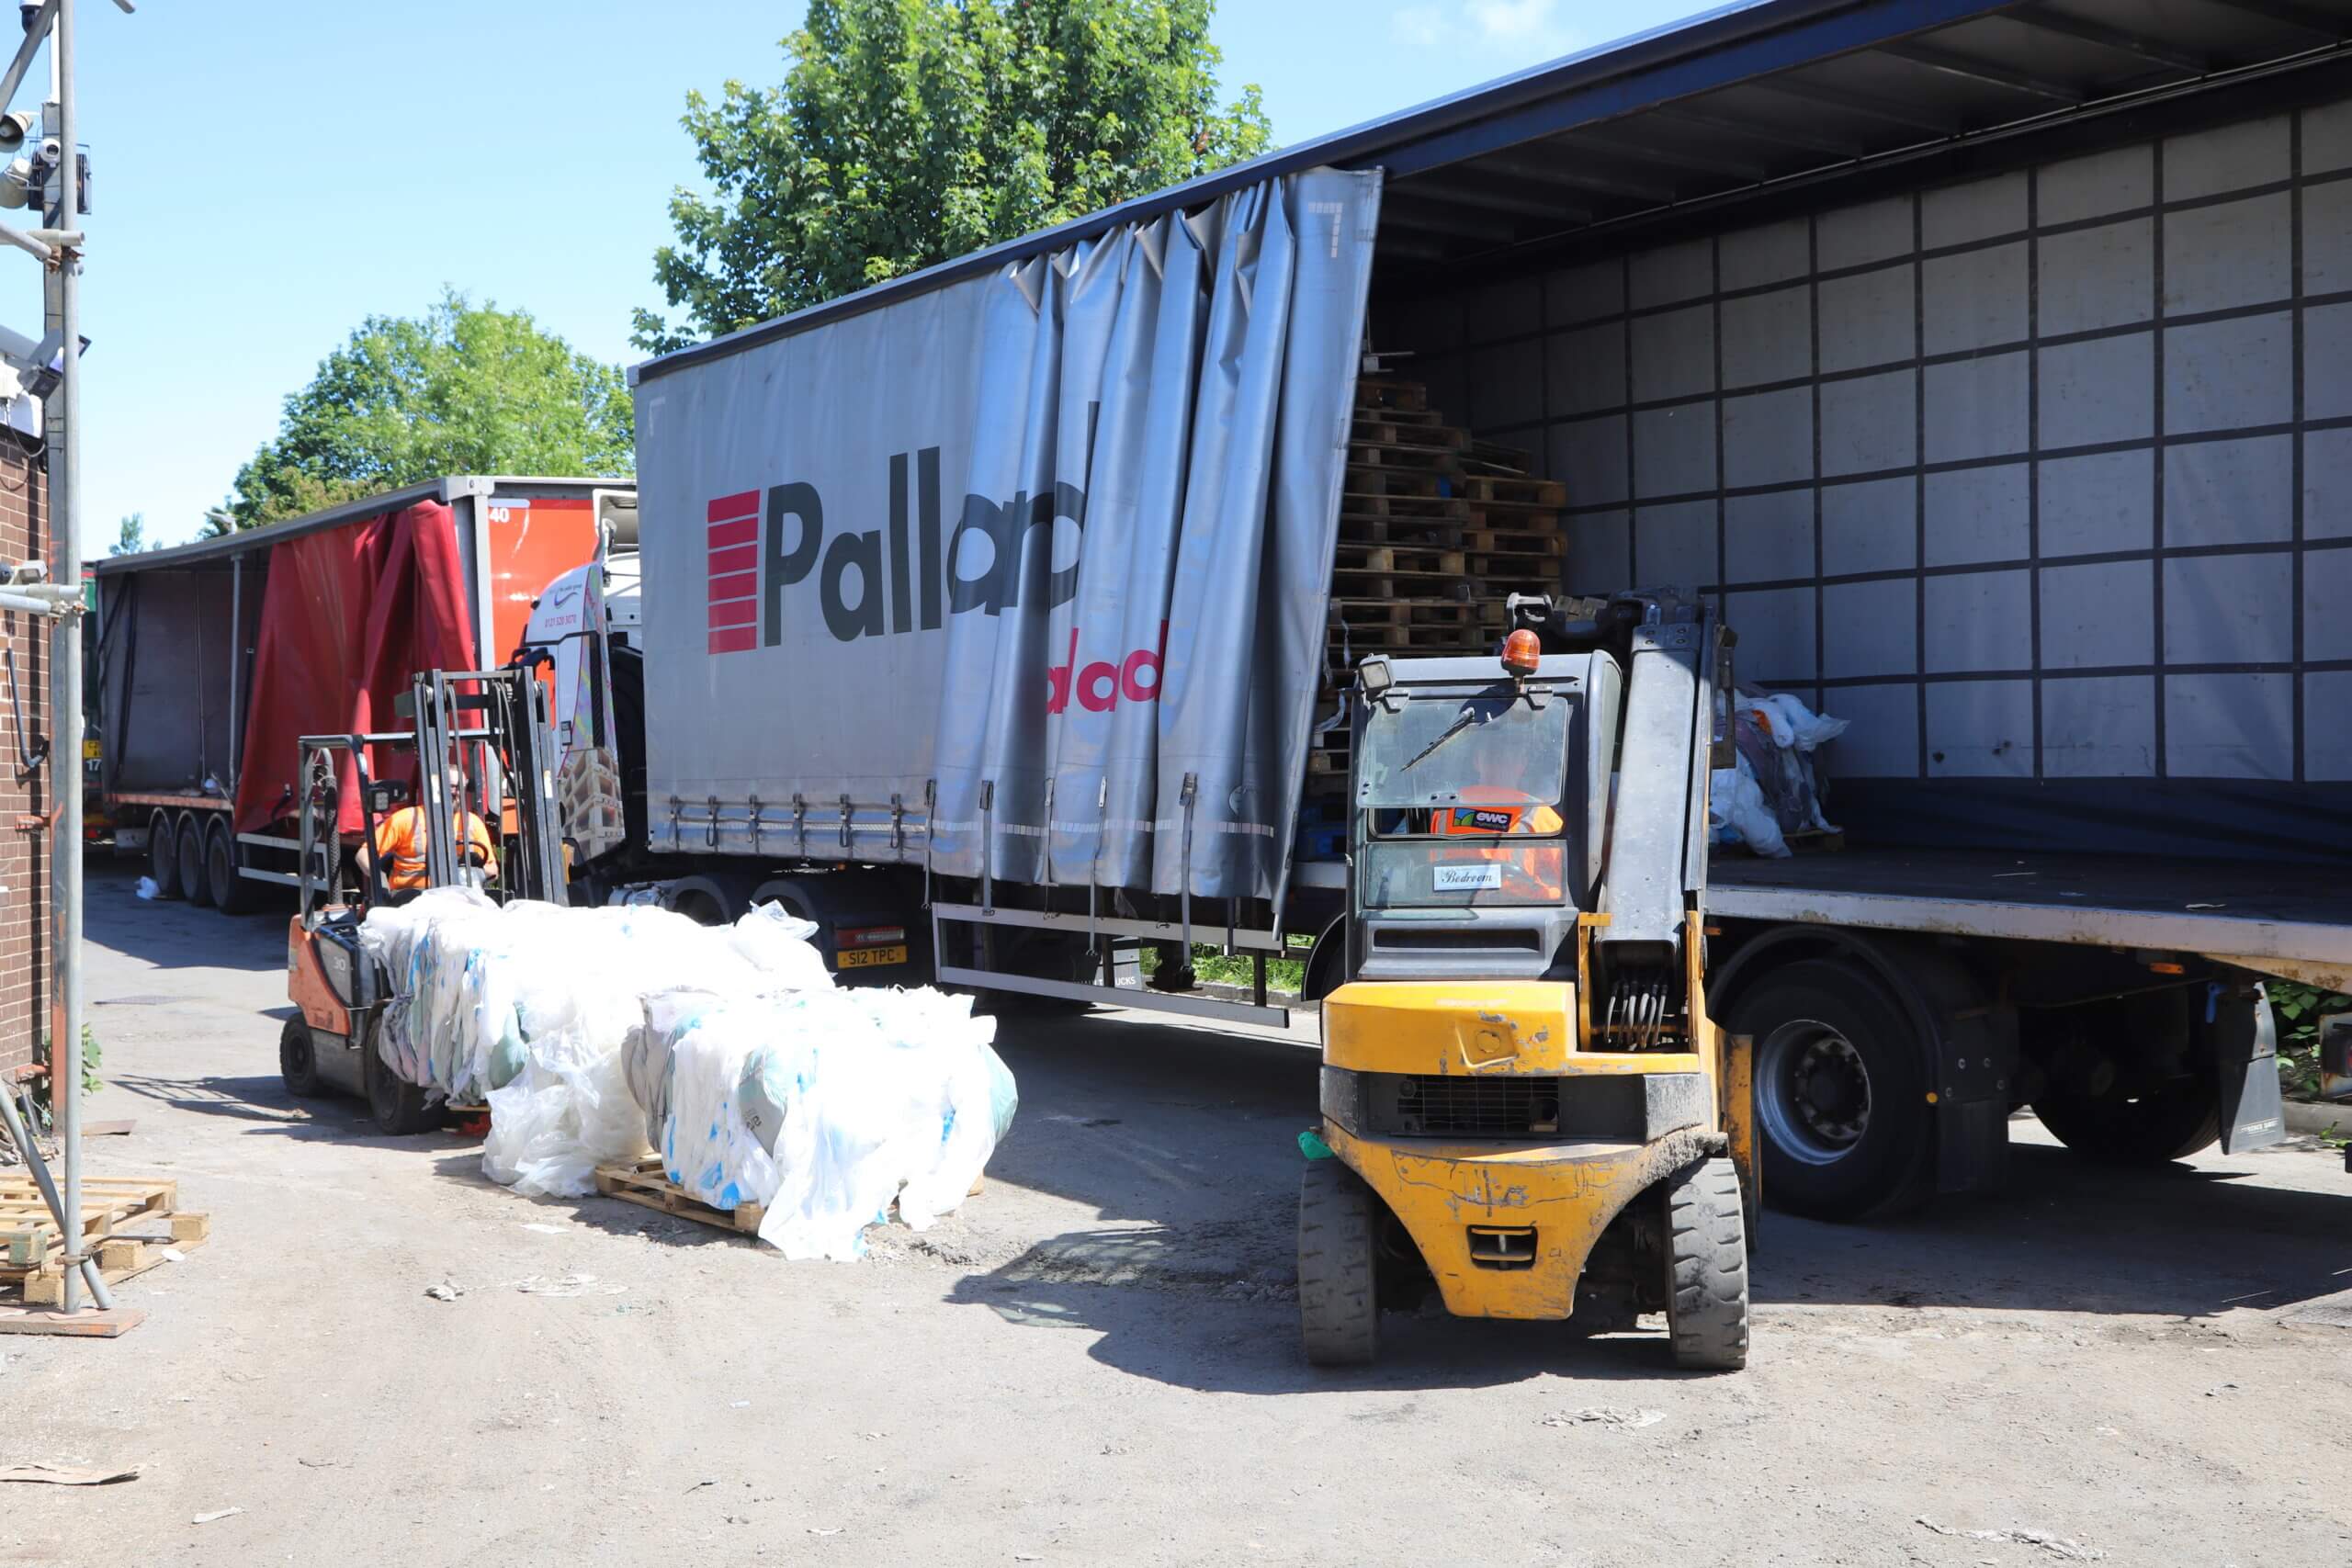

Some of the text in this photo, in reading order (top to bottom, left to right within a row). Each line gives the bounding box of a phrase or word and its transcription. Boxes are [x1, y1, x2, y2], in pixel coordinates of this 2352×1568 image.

[490, 507, 510, 524] 40
[1476, 812, 1508, 824] ewc
[848, 948, 896, 965] S12 TPC
